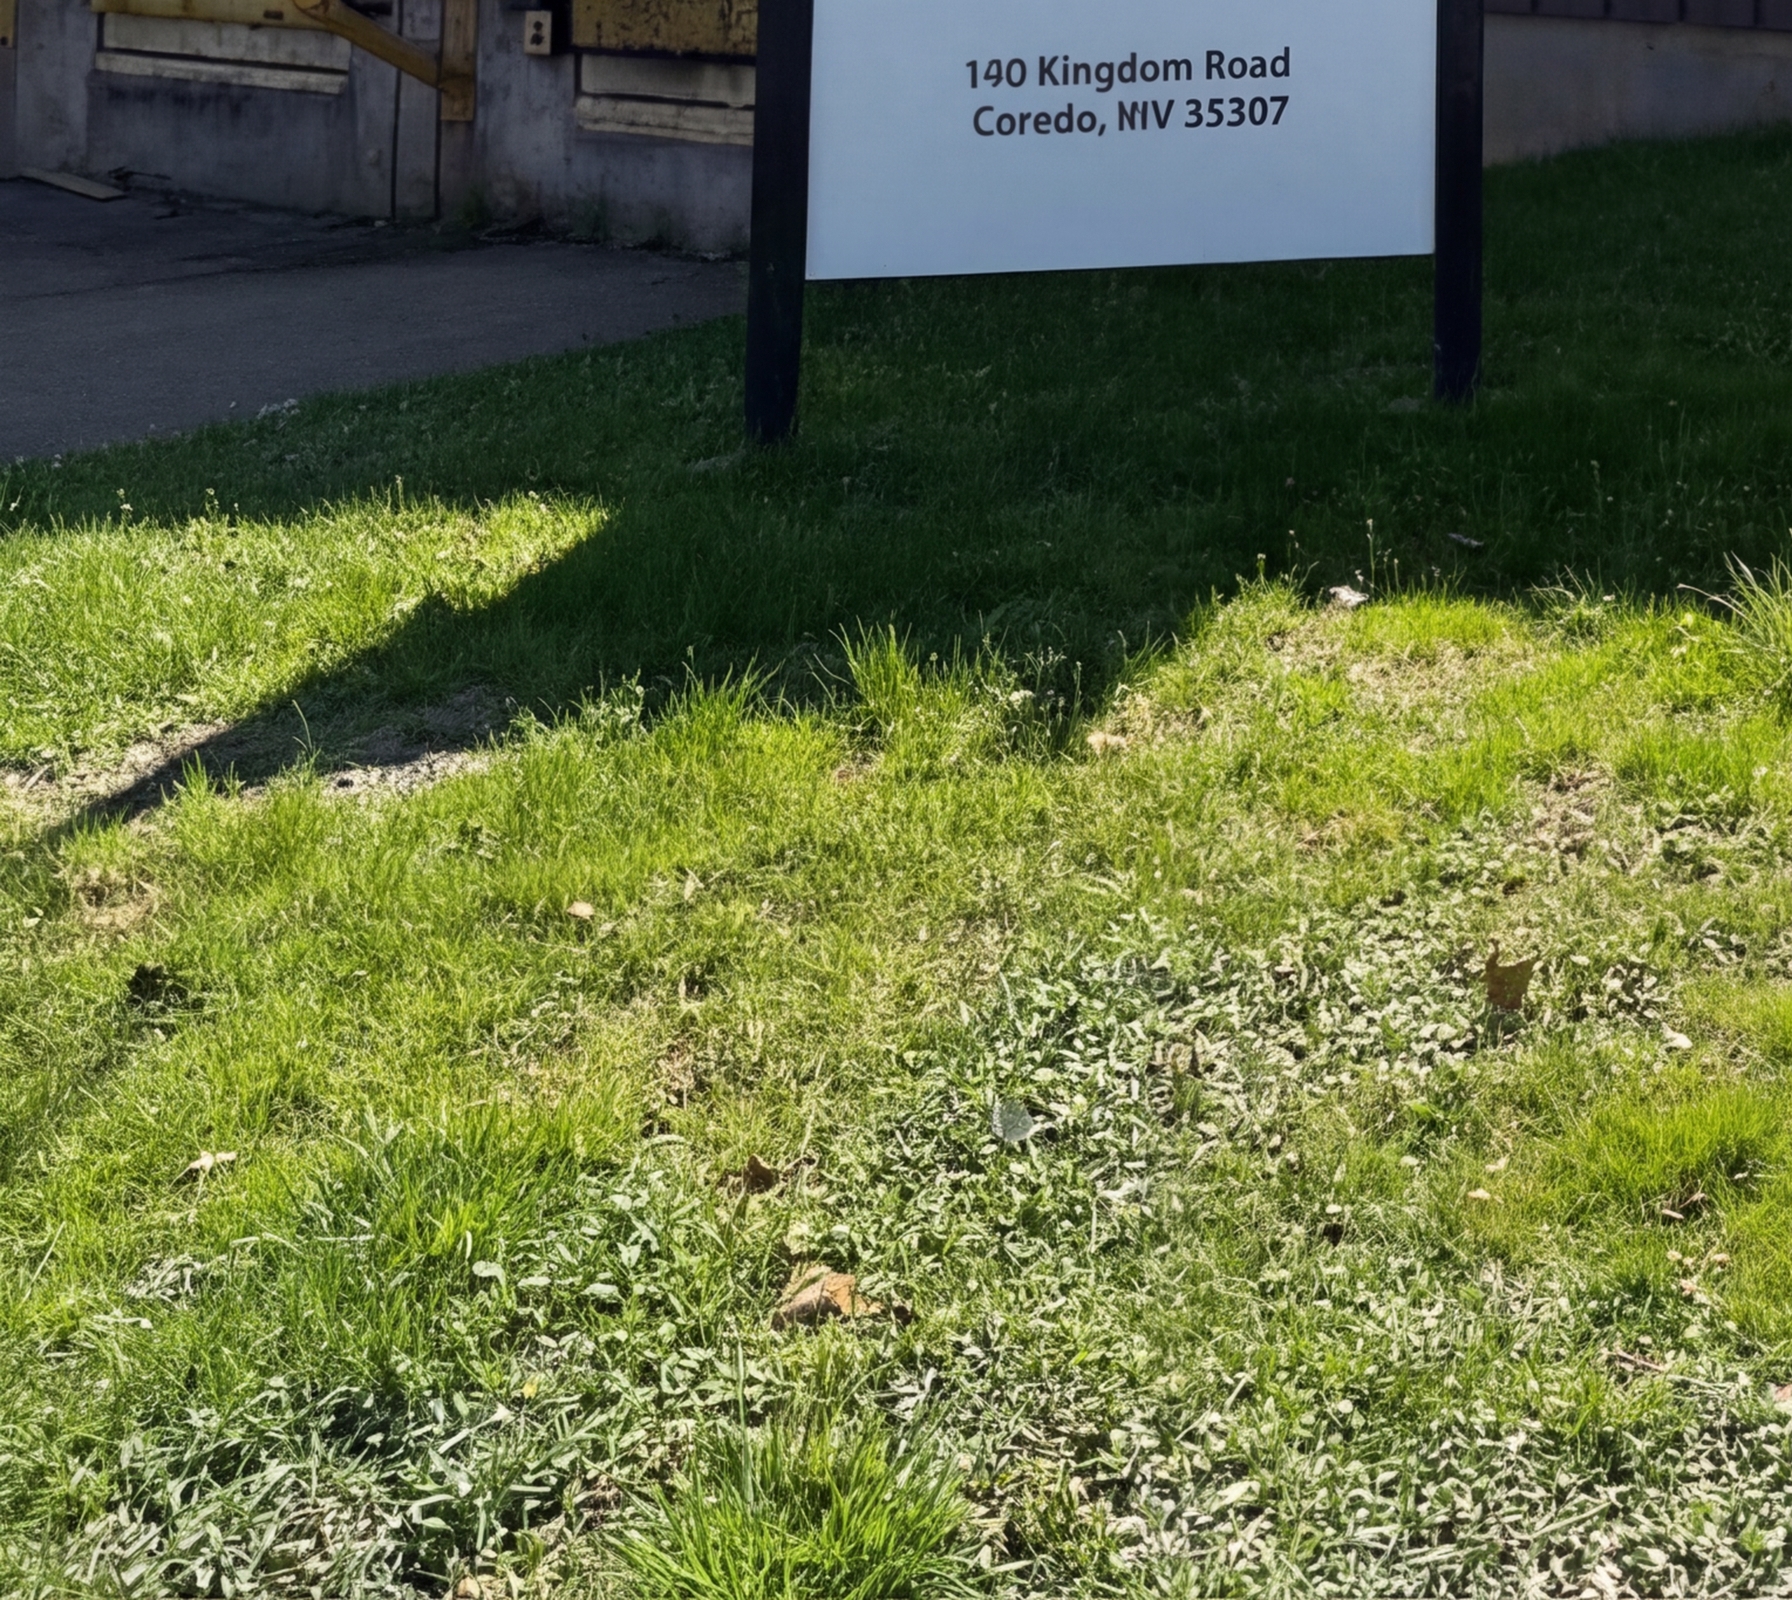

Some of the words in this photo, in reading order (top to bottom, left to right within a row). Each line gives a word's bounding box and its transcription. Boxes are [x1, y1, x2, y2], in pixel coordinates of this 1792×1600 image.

[1038, 52, 1192, 93] Kingdom
[1205, 46, 1290, 80] Road
[973, 102, 1106, 137] Coredo,
[1184, 95, 1290, 128] 35307
